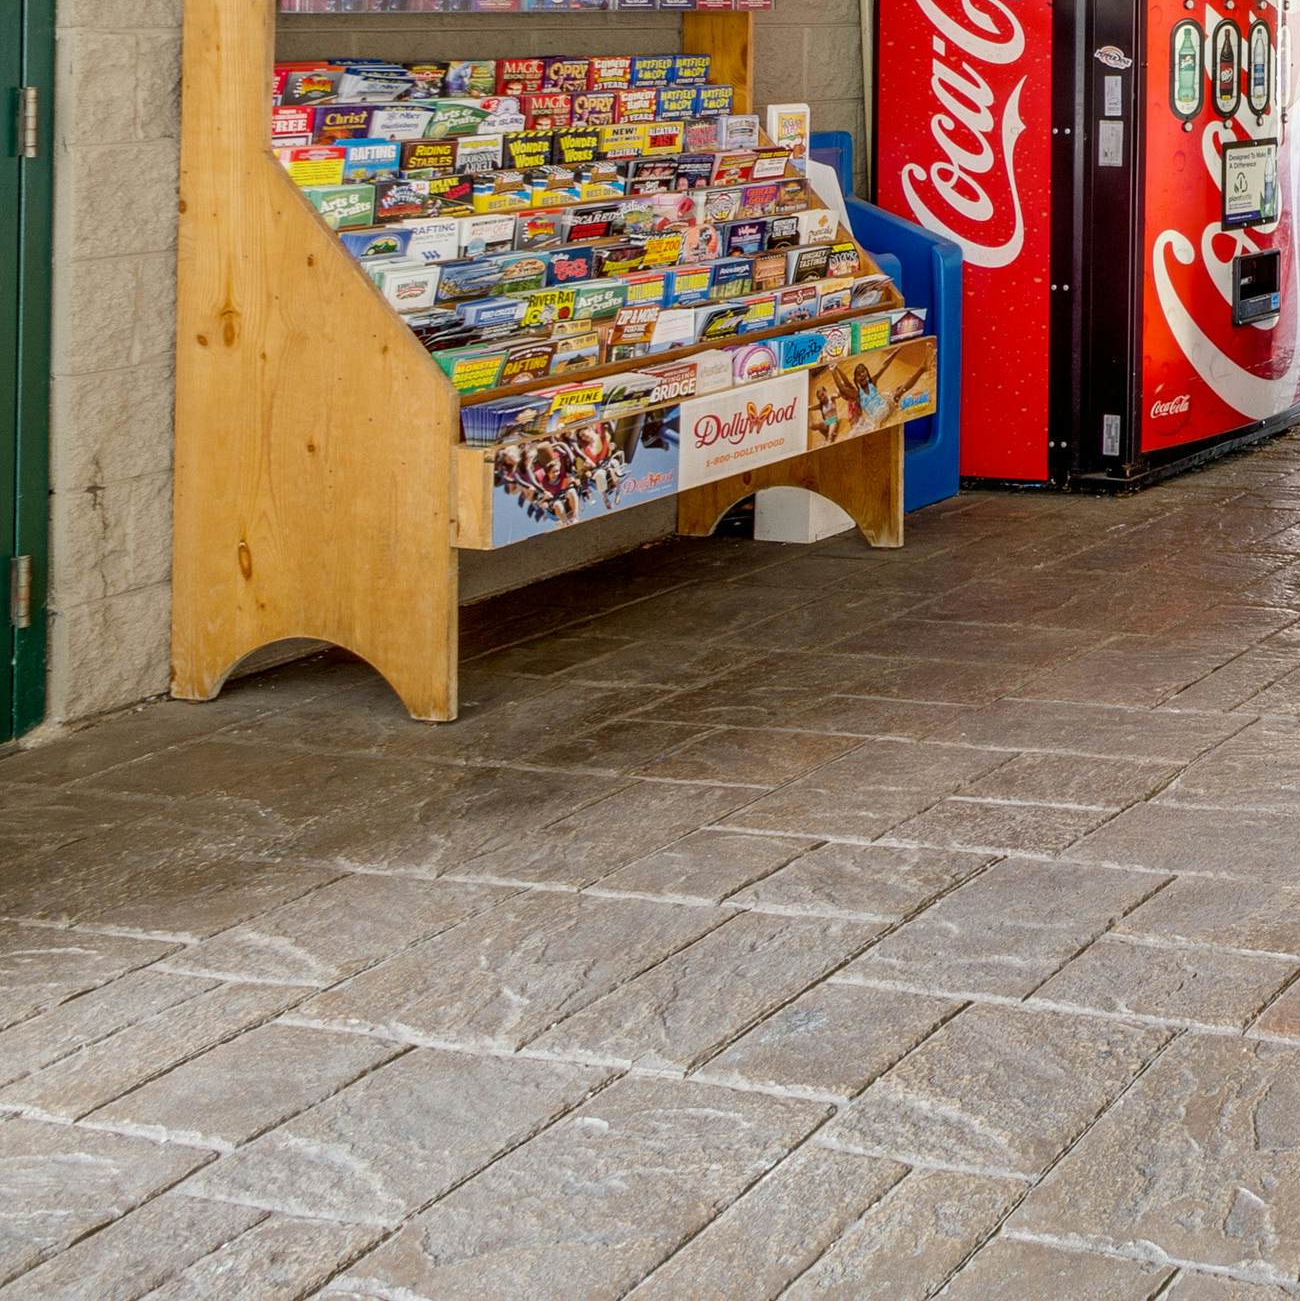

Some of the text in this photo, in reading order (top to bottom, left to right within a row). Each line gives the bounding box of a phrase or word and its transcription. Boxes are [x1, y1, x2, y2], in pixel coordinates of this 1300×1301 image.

[504, 61, 544, 74] MAGIC
[551, 62, 588, 80] OPRY
[531, 97, 571, 109] MAGIC
[574, 95, 613, 114] OPRY
[325, 110, 369, 126] Christ
[350, 145, 397, 161] RAFTING
[415, 145, 451, 156] RIDING
[407, 157, 453, 168] STABLES
[320, 198, 348, 213] Arts
[411, 222, 456, 236] RAFTING
[558, 290, 575, 304] RAT
[503, 355, 549, 376] RAFTING
[650, 378, 697, 403] BRIDGE
[559, 391, 600, 406] ZIPLINE
[1150, 394, 1191, 419] Coca-Cola
